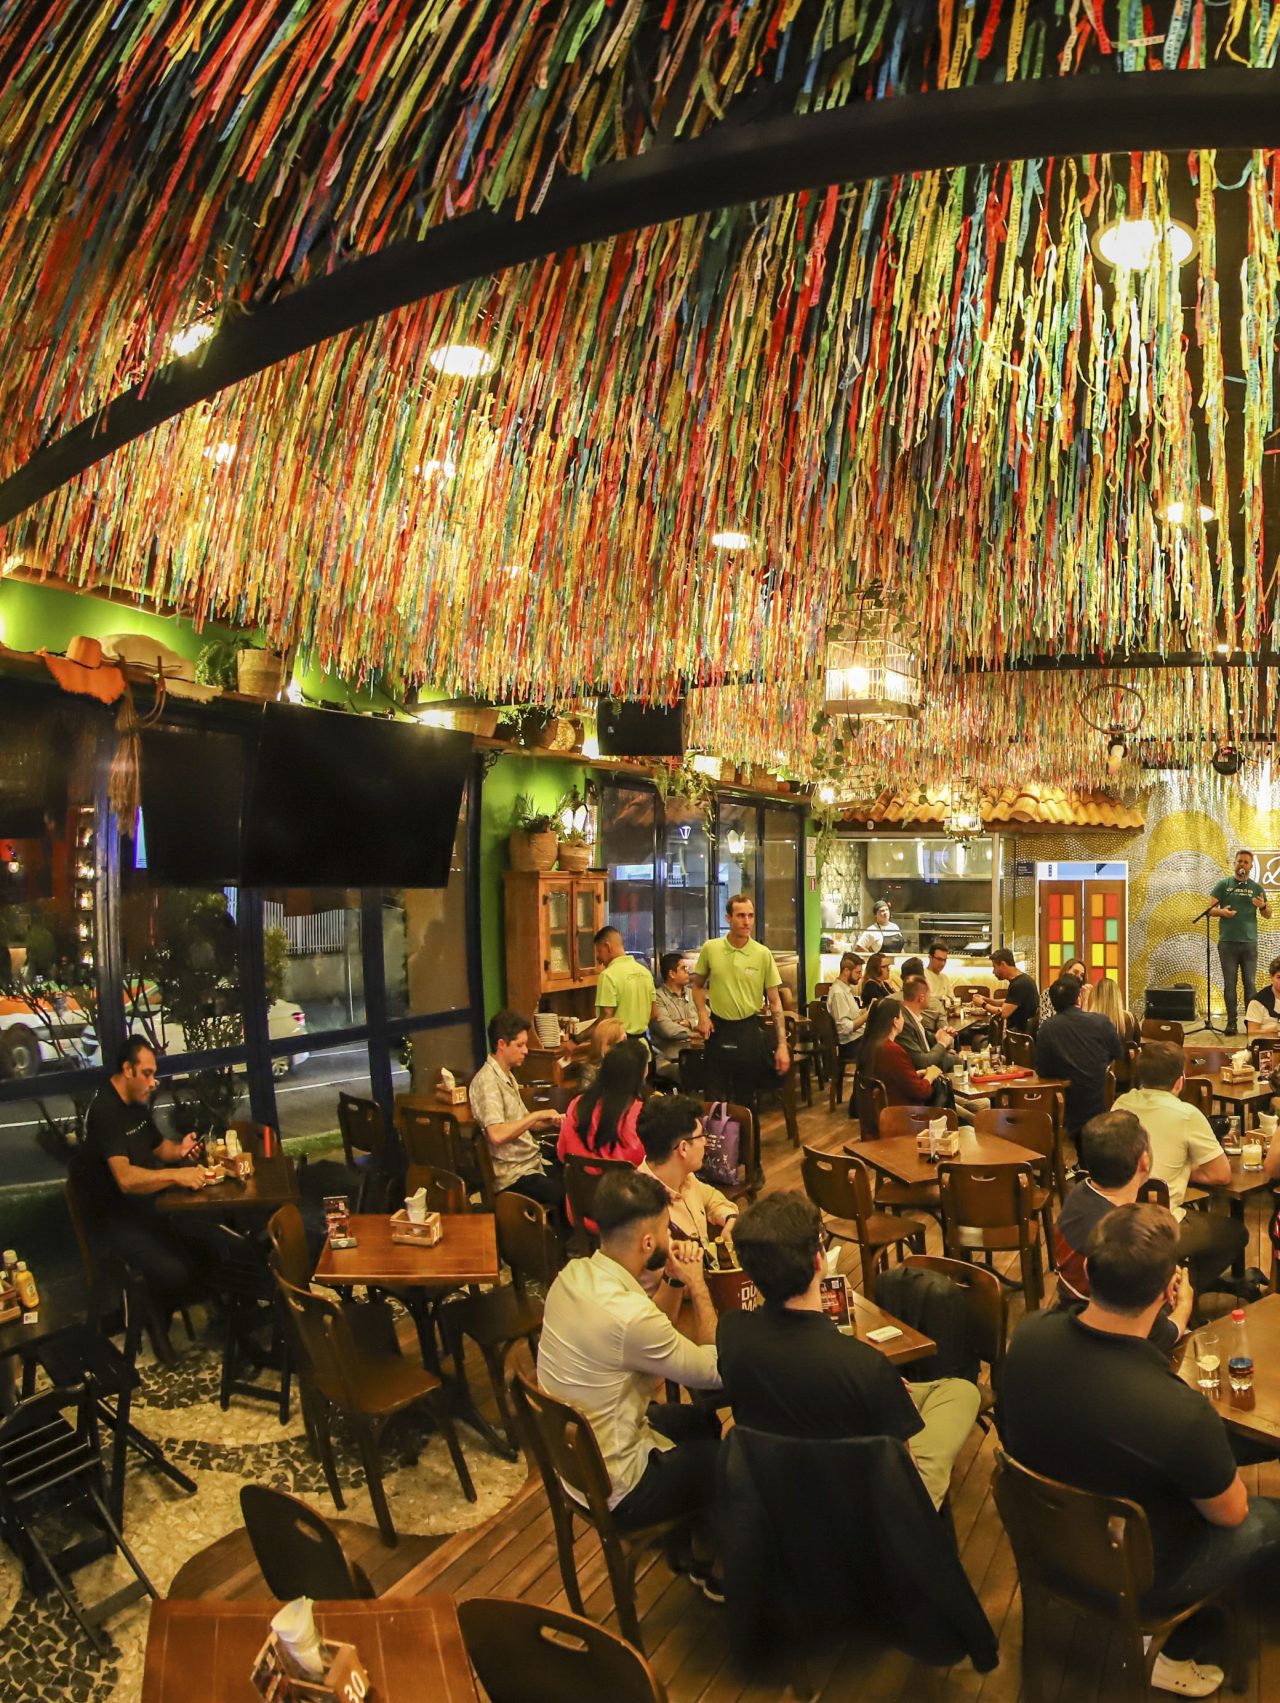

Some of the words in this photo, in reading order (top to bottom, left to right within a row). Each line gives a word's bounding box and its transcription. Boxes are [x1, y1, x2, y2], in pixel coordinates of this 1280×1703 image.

[455, 1091, 465, 1103] 15
[239, 1160, 251, 1175] 28
[343, 1670, 366, 1703] 30
